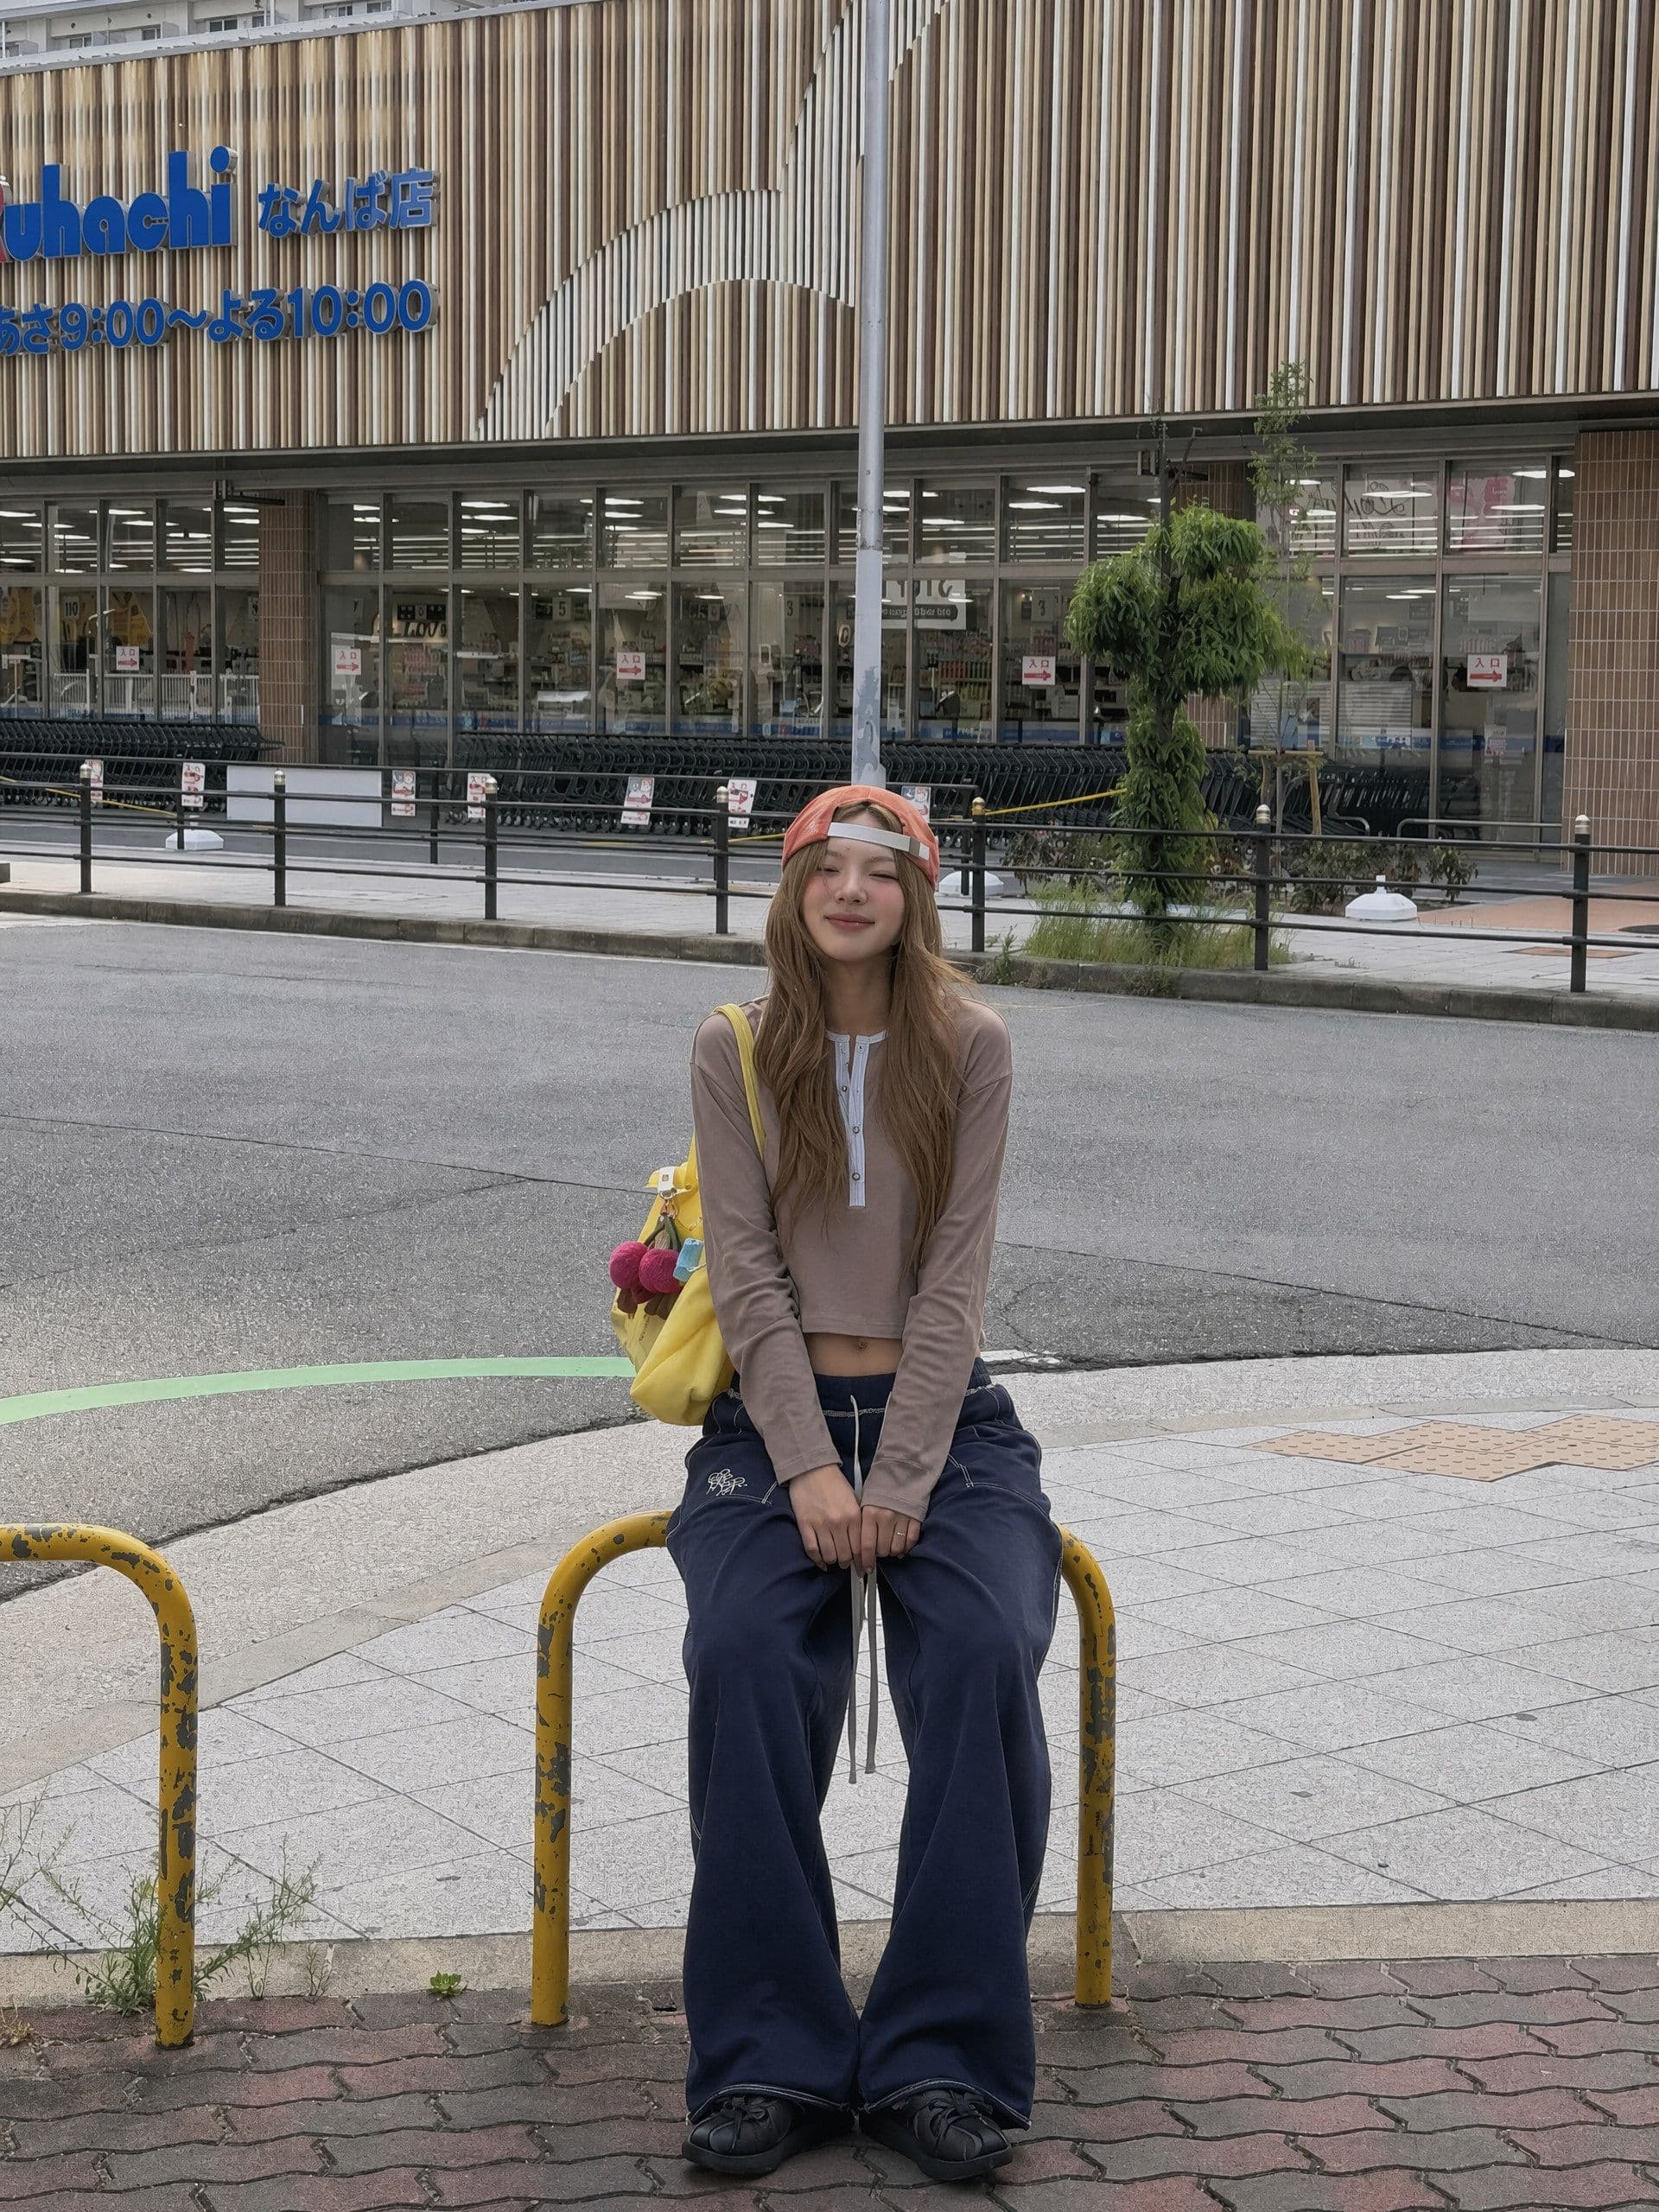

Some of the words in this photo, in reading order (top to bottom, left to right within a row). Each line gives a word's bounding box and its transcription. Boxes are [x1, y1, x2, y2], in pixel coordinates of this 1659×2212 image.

[0, 145, 233, 262] uhachi
[257, 167, 434, 238] なんば店
[558, 601, 566, 616] 5
[340, 651, 357, 660] 入口
[621, 654, 640, 664] 入口
[1029, 659, 1049, 668] 入口
[1475, 658, 1500, 668] 入口
